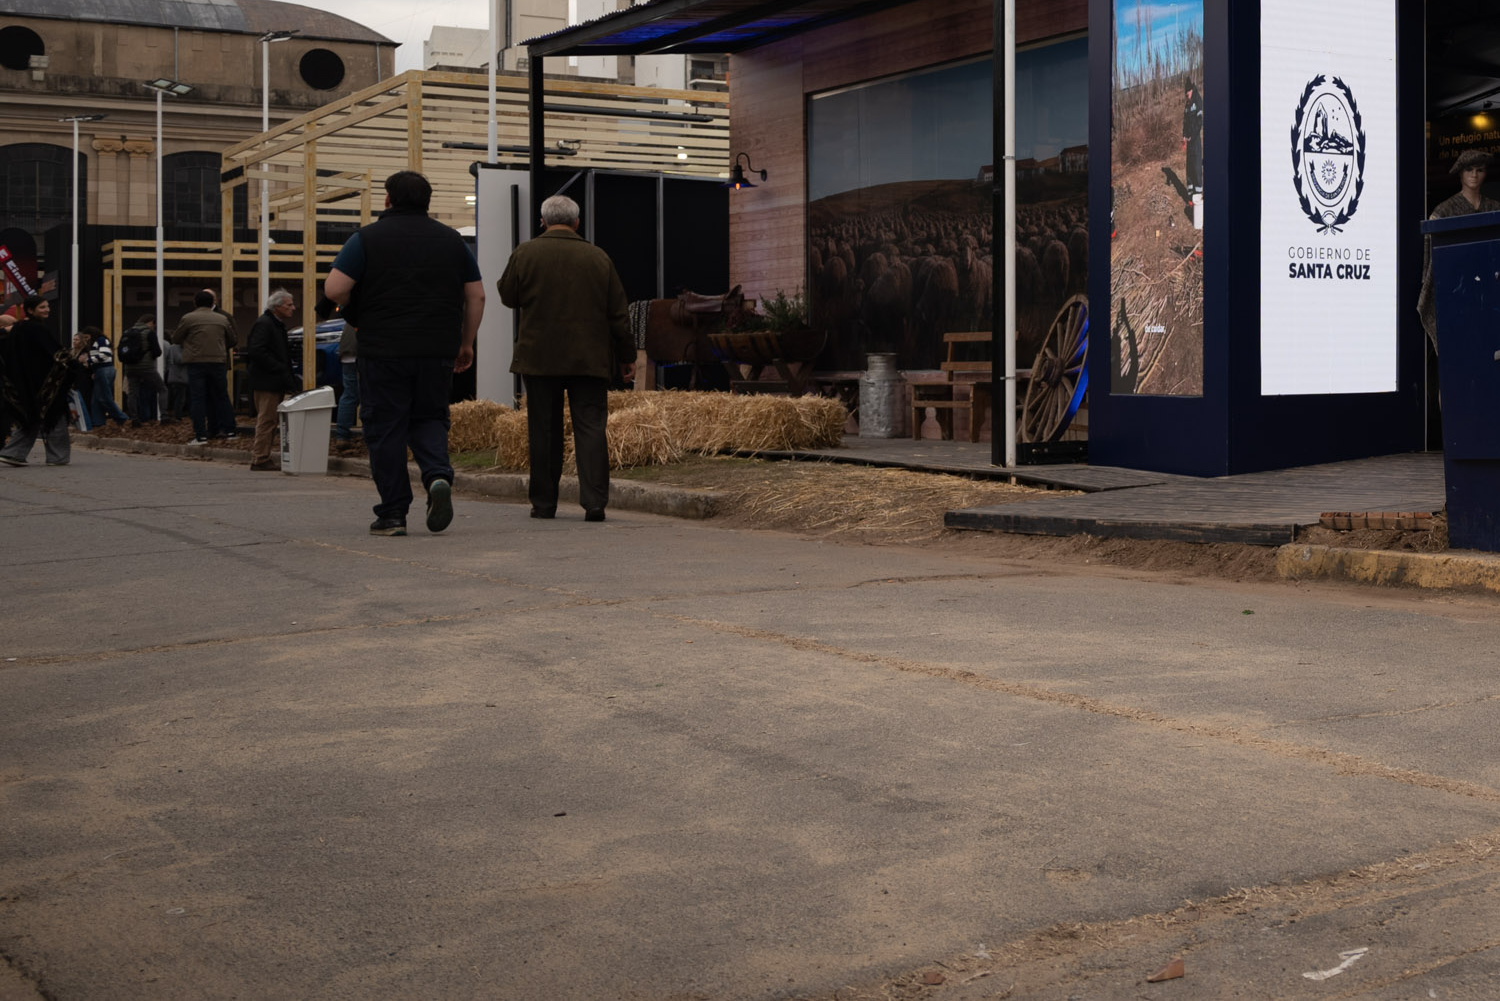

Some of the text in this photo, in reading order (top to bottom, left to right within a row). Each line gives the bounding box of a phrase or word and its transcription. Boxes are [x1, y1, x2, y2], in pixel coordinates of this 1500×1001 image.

[1439, 135, 1451, 147] Un
[1452, 132, 1482, 145] refugio
[1288, 246, 1371, 261] GOBIERNO DE
[1289, 262, 1370, 280] SANTA CRUZ
